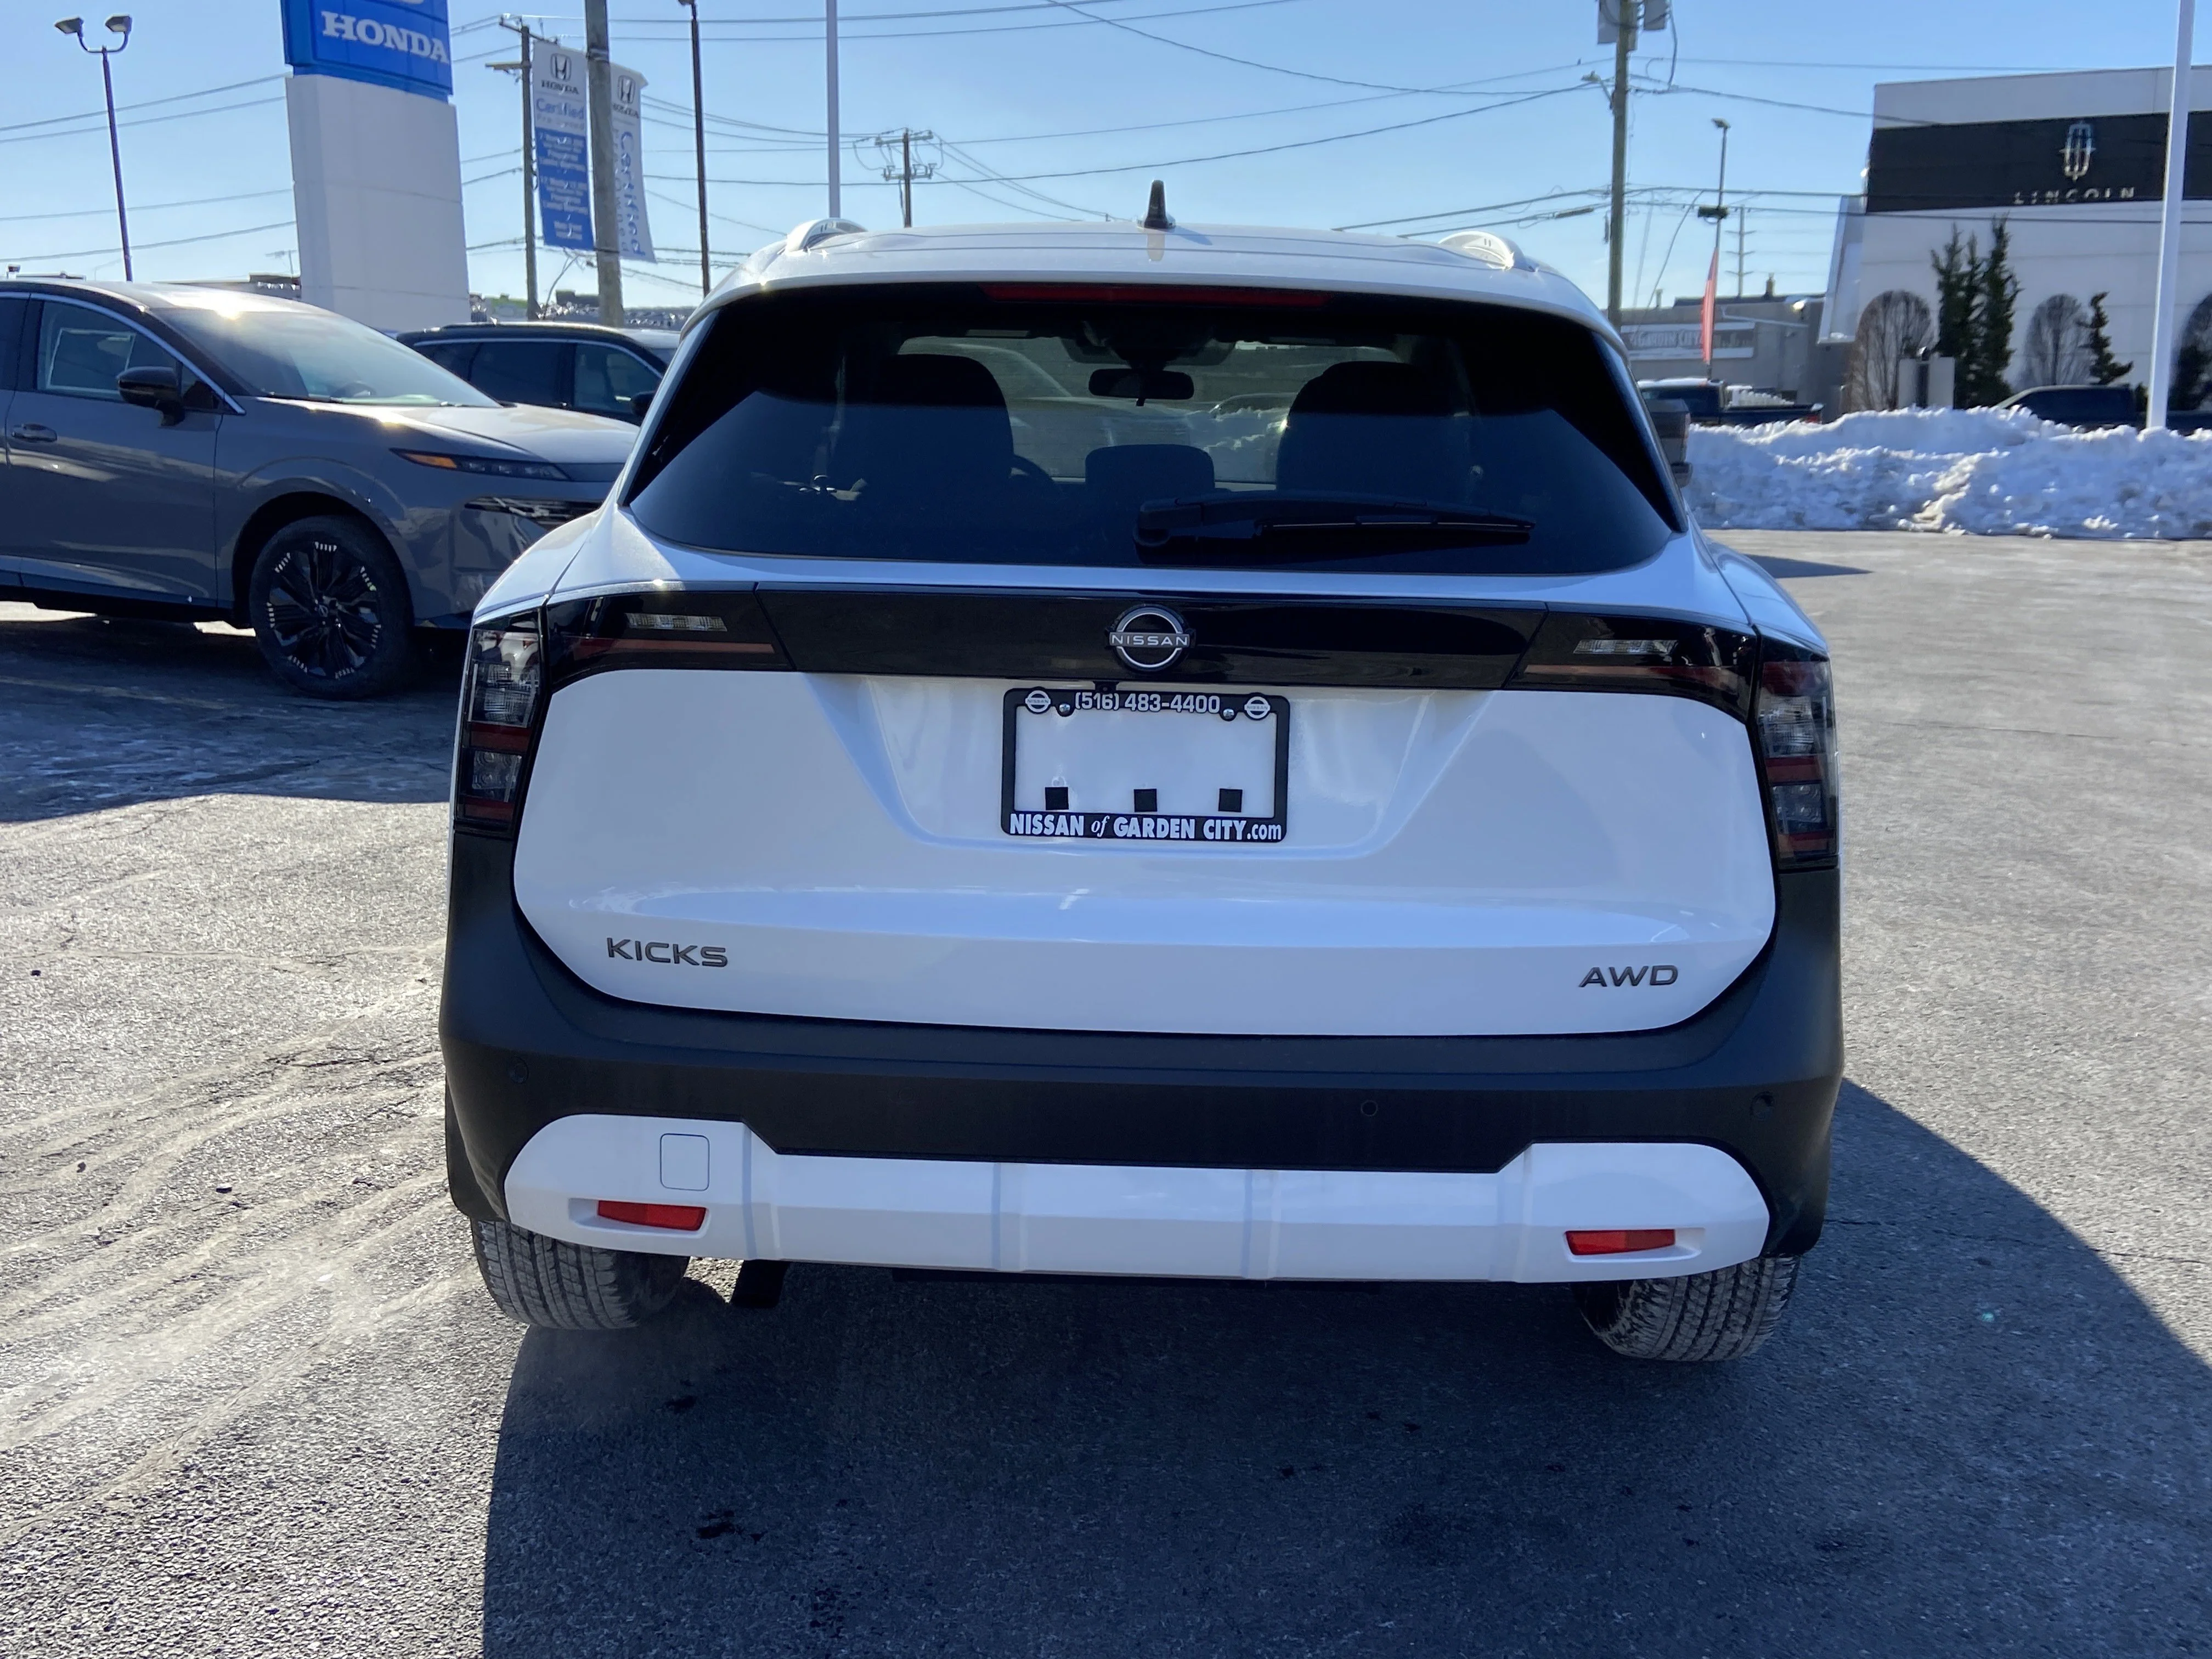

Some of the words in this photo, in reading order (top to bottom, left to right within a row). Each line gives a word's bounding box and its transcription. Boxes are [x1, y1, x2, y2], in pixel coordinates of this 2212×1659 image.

[321, 11, 450, 64] HONDA
[541, 80, 579, 95] HONDA
[2013, 187, 2135, 205] LINCOLN
[1111, 635, 1188, 646] NISSAN
[1075, 692, 1120, 710] (516)
[1125, 693, 1220, 713] 483-4400
[1010, 813, 1084, 836] NISSAN
[1091, 815, 1109, 837] of
[1114, 817, 1195, 839] GARDEN
[1203, 820, 1282, 840] CITY.com
[607, 938, 727, 967] KICKS
[1579, 965, 1678, 987] AWD
